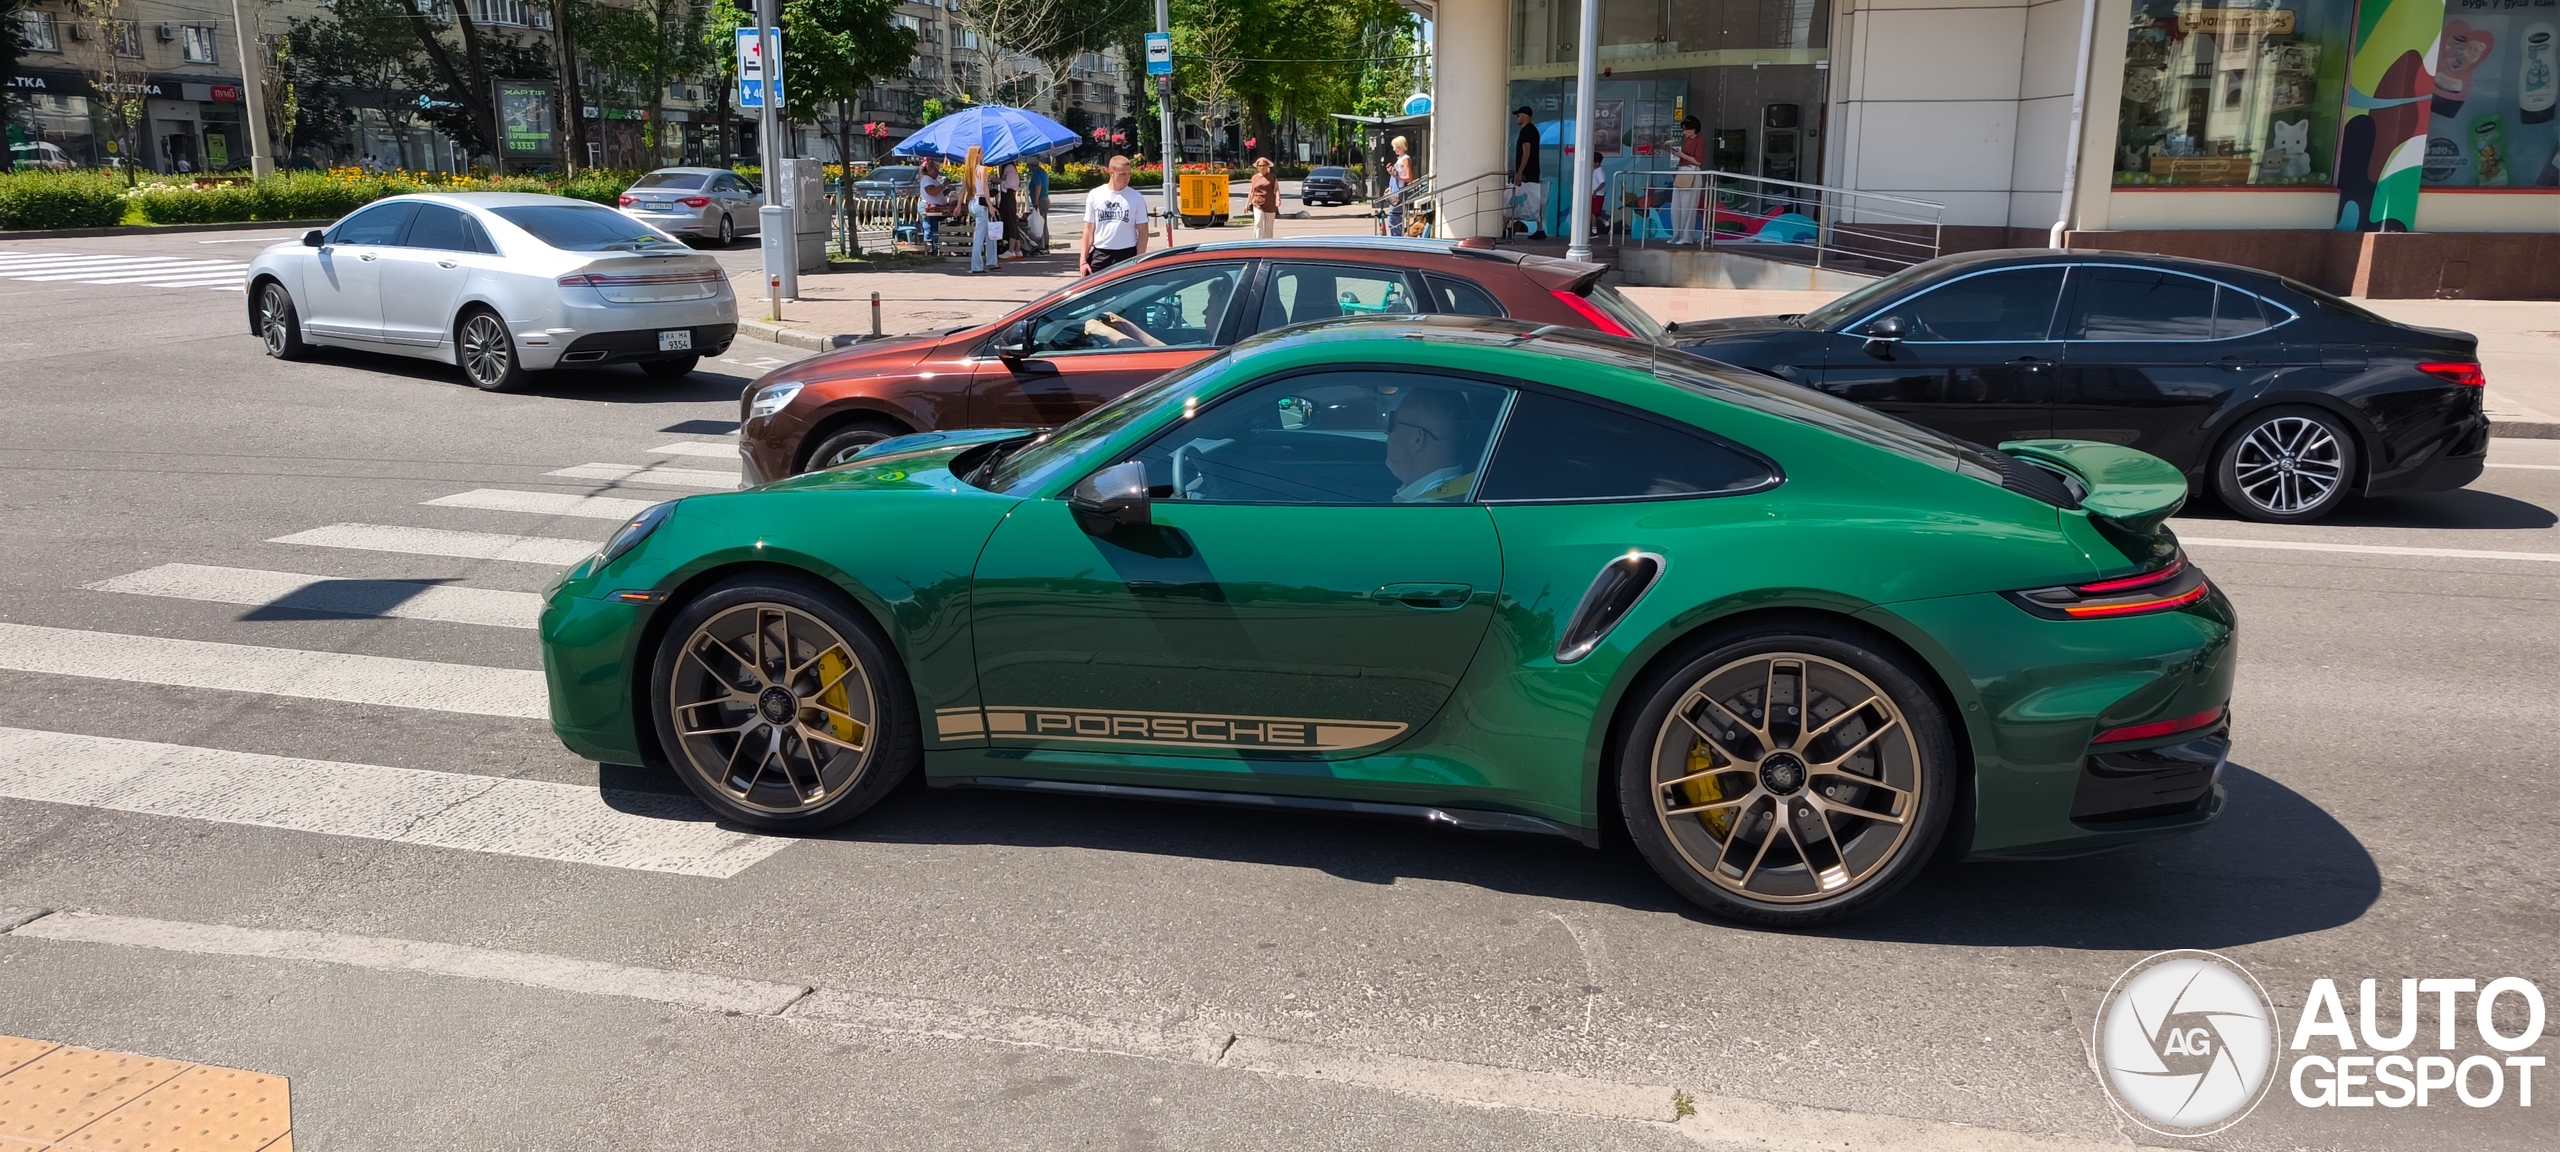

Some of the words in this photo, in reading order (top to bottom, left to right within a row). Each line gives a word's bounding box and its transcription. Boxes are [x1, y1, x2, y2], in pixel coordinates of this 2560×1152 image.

[2184, 12, 2238, 29] Sylvanian
[516, 141, 536, 150] 3333
[668, 340, 688, 349] 9354
[1037, 713, 1305, 744] PORSCHE
